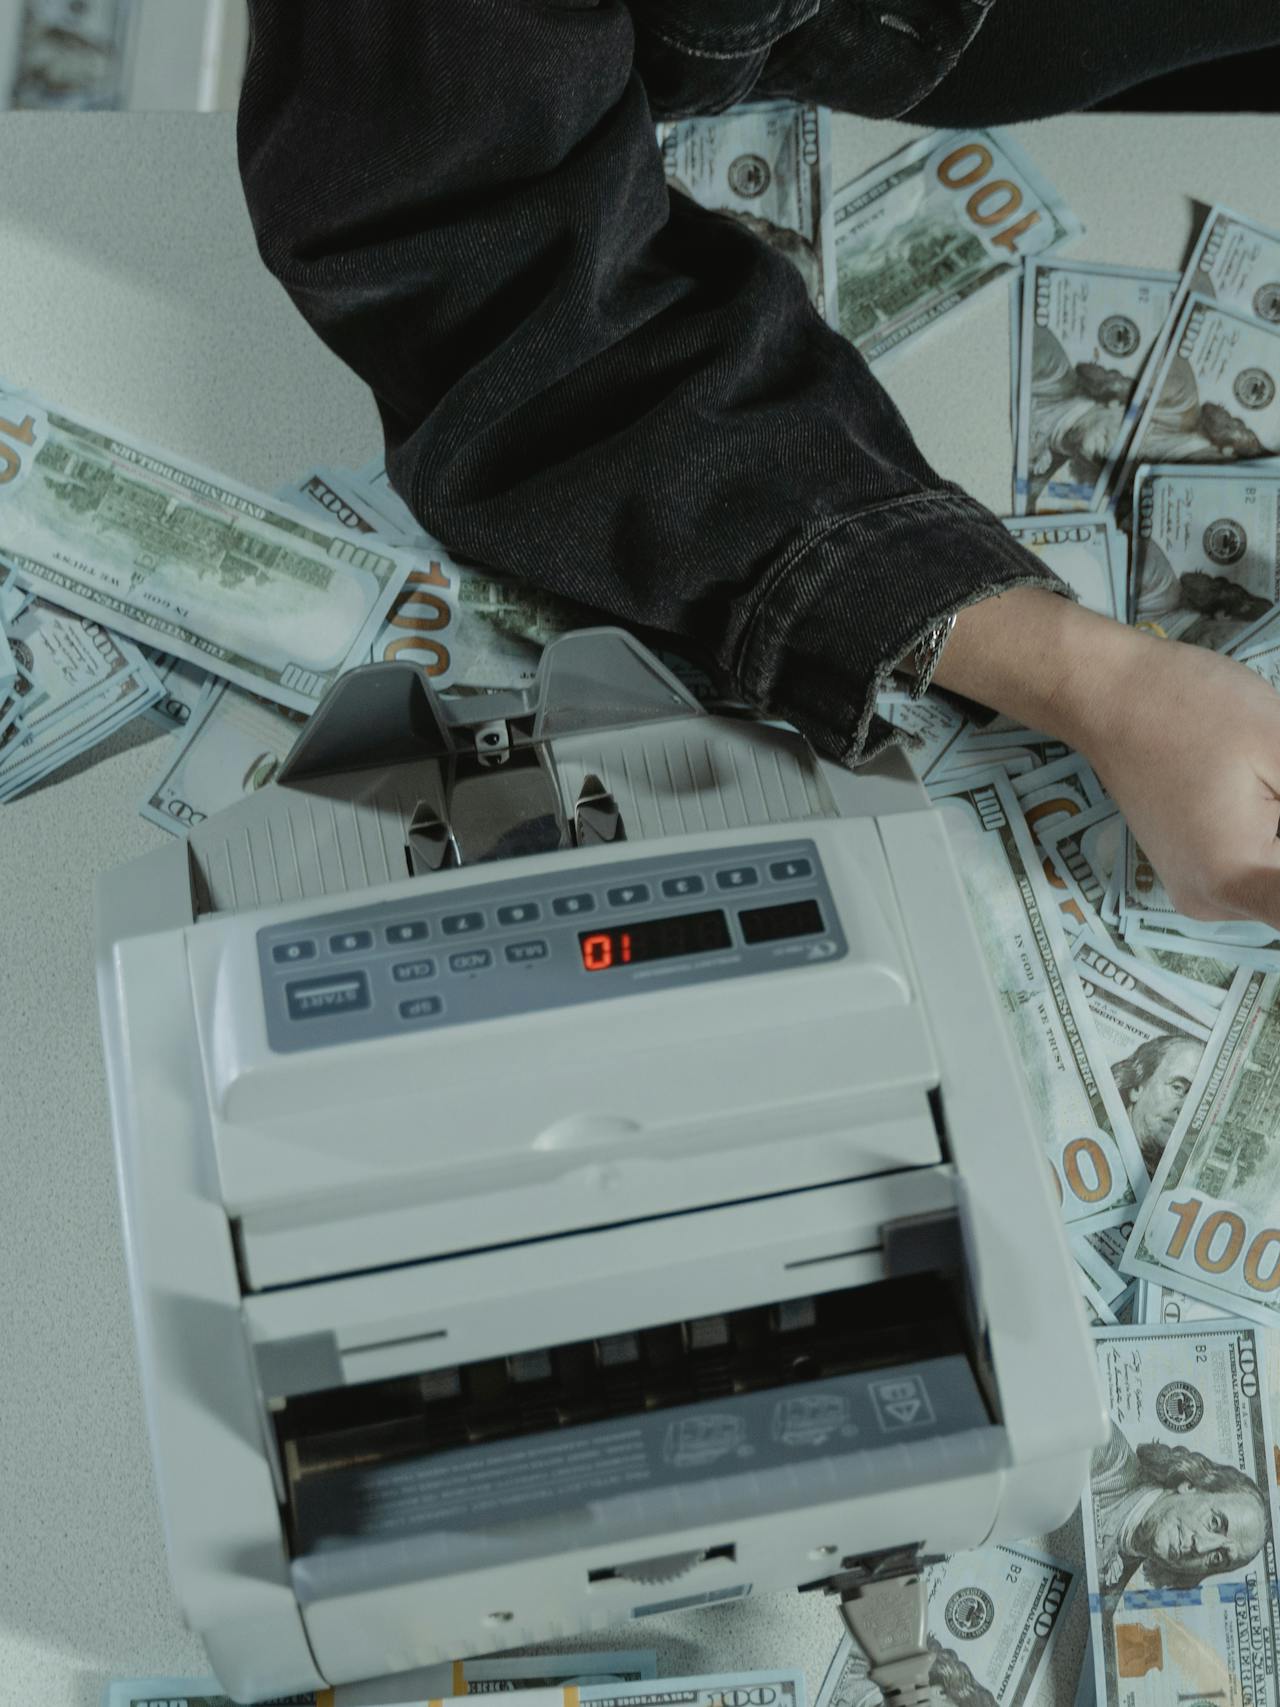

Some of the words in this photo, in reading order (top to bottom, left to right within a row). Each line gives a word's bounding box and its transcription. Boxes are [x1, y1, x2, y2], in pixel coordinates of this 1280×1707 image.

[921, 131, 1054, 258] 100
[1244, 486, 1256, 504] B2
[1031, 527, 1091, 545] 100
[51, 549, 100, 578] TRUST
[98, 570, 124, 589] WE
[140, 590, 172, 612] GOD
[171, 604, 191, 621] IN
[382, 559, 453, 678] 100
[970, 784, 1007, 832] 100
[457, 917, 467, 930] 7
[579, 929, 634, 972] 10
[1012, 932, 1026, 950] IN
[453, 951, 487, 969] ADD
[1018, 951, 1036, 983] GOD
[1079, 947, 1140, 992] 100
[299, 987, 358, 1010] START
[1034, 1001, 1051, 1026] WE
[1123, 1021, 1152, 1043] NOTE
[1042, 1027, 1067, 1075] TRUST
[1193, 1343, 1208, 1364] B2
[1226, 1342, 1238, 1390] FEDERAL
[1235, 1333, 1259, 1398] 100
[1230, 1390, 1243, 1441] RESERVE
[1235, 1441, 1246, 1471] NOTE
[1023, 1572, 1076, 1641] 100
[1025, 1574, 1050, 1623] FEDERAL
